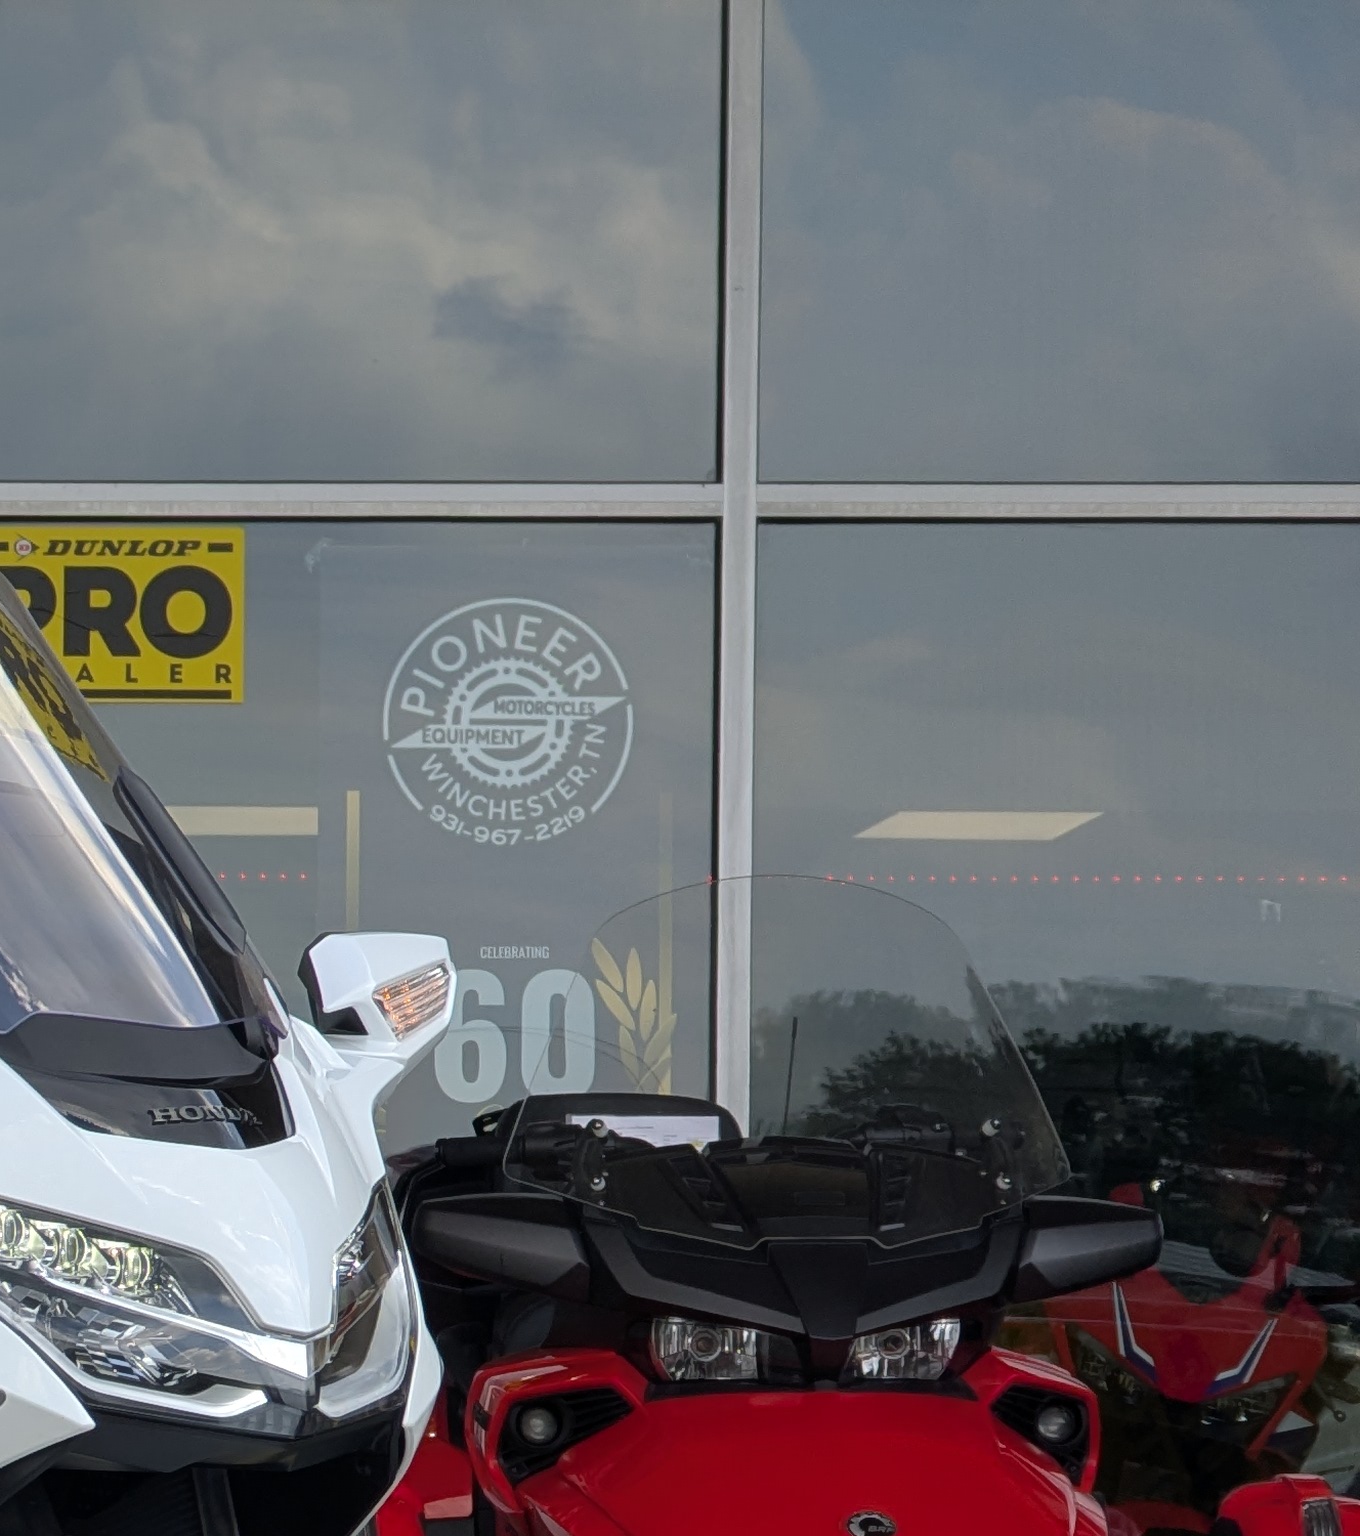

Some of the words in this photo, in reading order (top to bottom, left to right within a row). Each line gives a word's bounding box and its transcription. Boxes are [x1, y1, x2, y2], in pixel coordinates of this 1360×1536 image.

[42, 539, 202, 557] DUNLOP
[400, 613, 603, 717] PIONEER
[493, 699, 596, 716] MOTORCYCLES
[421, 727, 526, 747] EQUIPMENT
[578, 722, 608, 760] TN
[429, 804, 586, 846] 931-967-2219
[480, 946, 551, 960] CELEBRATING
[434, 968, 596, 1104] 60
[148, 1105, 263, 1125] HONDA
